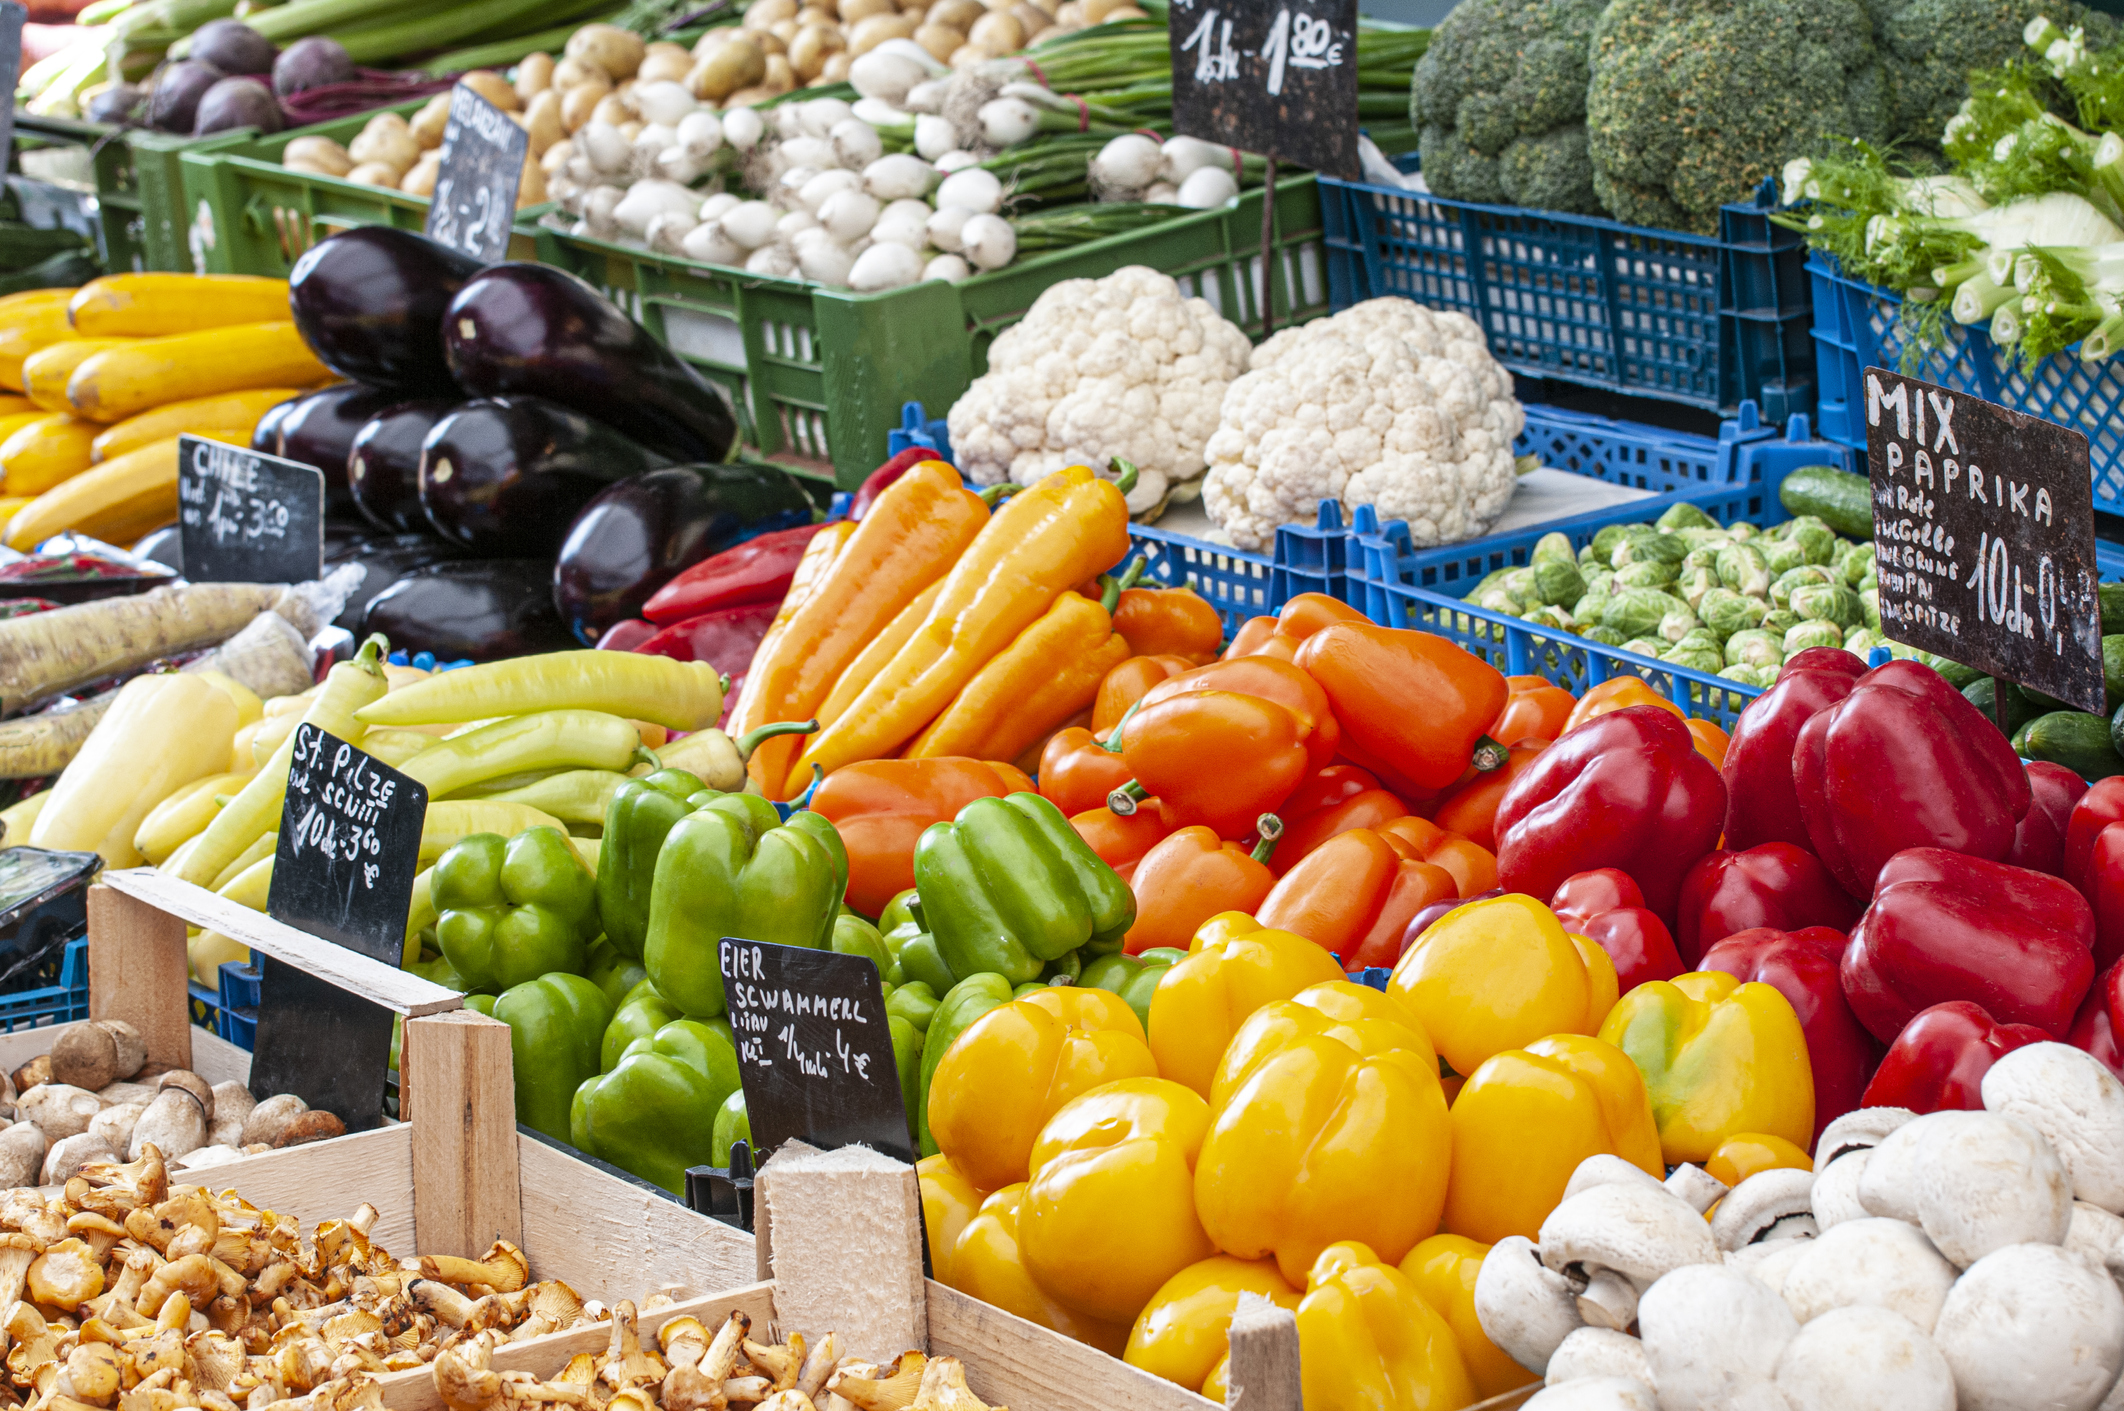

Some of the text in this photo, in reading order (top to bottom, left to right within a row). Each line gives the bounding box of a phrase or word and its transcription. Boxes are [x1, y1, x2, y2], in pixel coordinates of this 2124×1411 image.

[1866, 373, 1960, 455] MIX
[193, 443, 261, 493] CHILE
[1886, 442, 2052, 528] PAPRIKA
[720, 941, 765, 981] EIER
[735, 982, 868, 1024] SCWAMMERL
